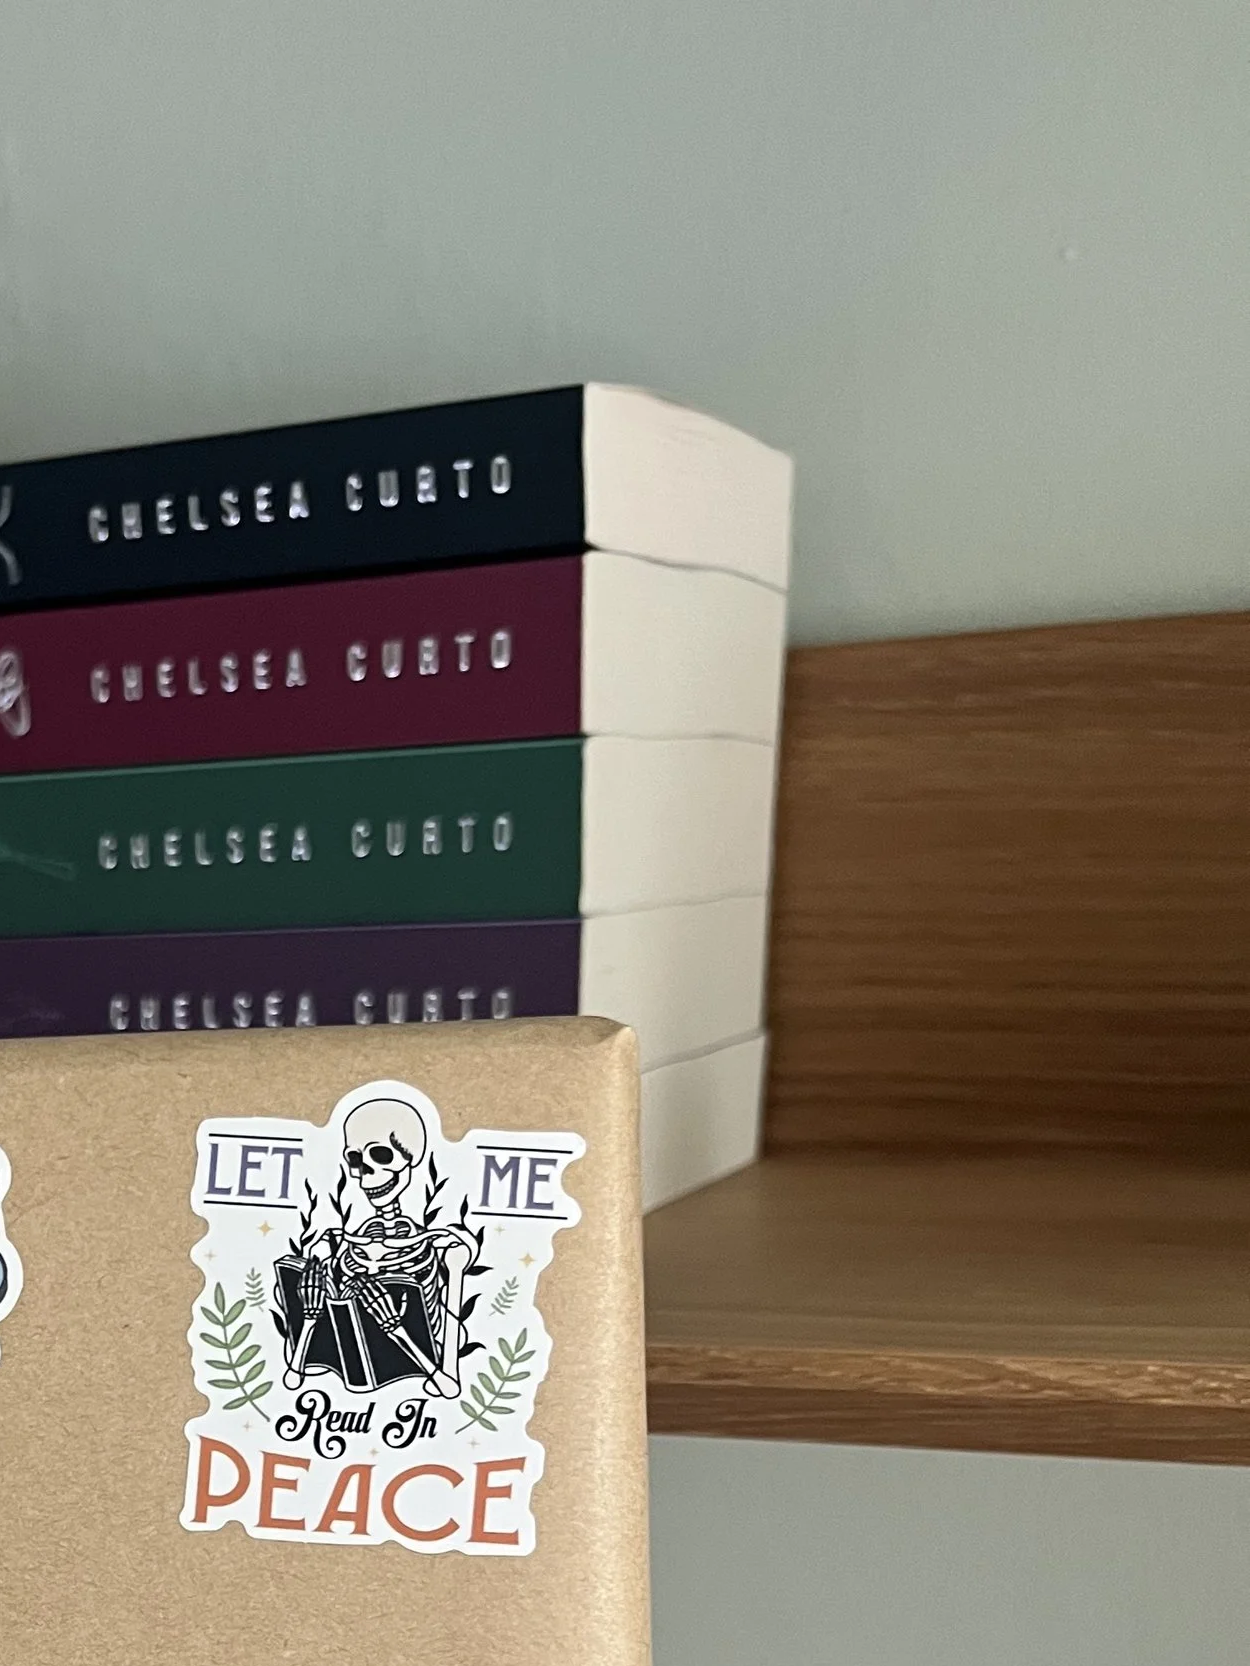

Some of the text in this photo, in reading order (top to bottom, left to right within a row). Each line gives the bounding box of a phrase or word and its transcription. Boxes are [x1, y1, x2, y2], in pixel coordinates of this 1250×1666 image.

[87, 455, 512, 543] CHELSEA CURTO
[90, 629, 513, 703] CHELSEA CURTO
[97, 812, 513, 870] CHELSEA CURTO
[108, 986, 514, 1031] CHELSEA CURTO
[207, 1142, 559, 1211] LET ME
[275, 1389, 437, 1459] Read In
[190, 1435, 528, 1546] PEACE
